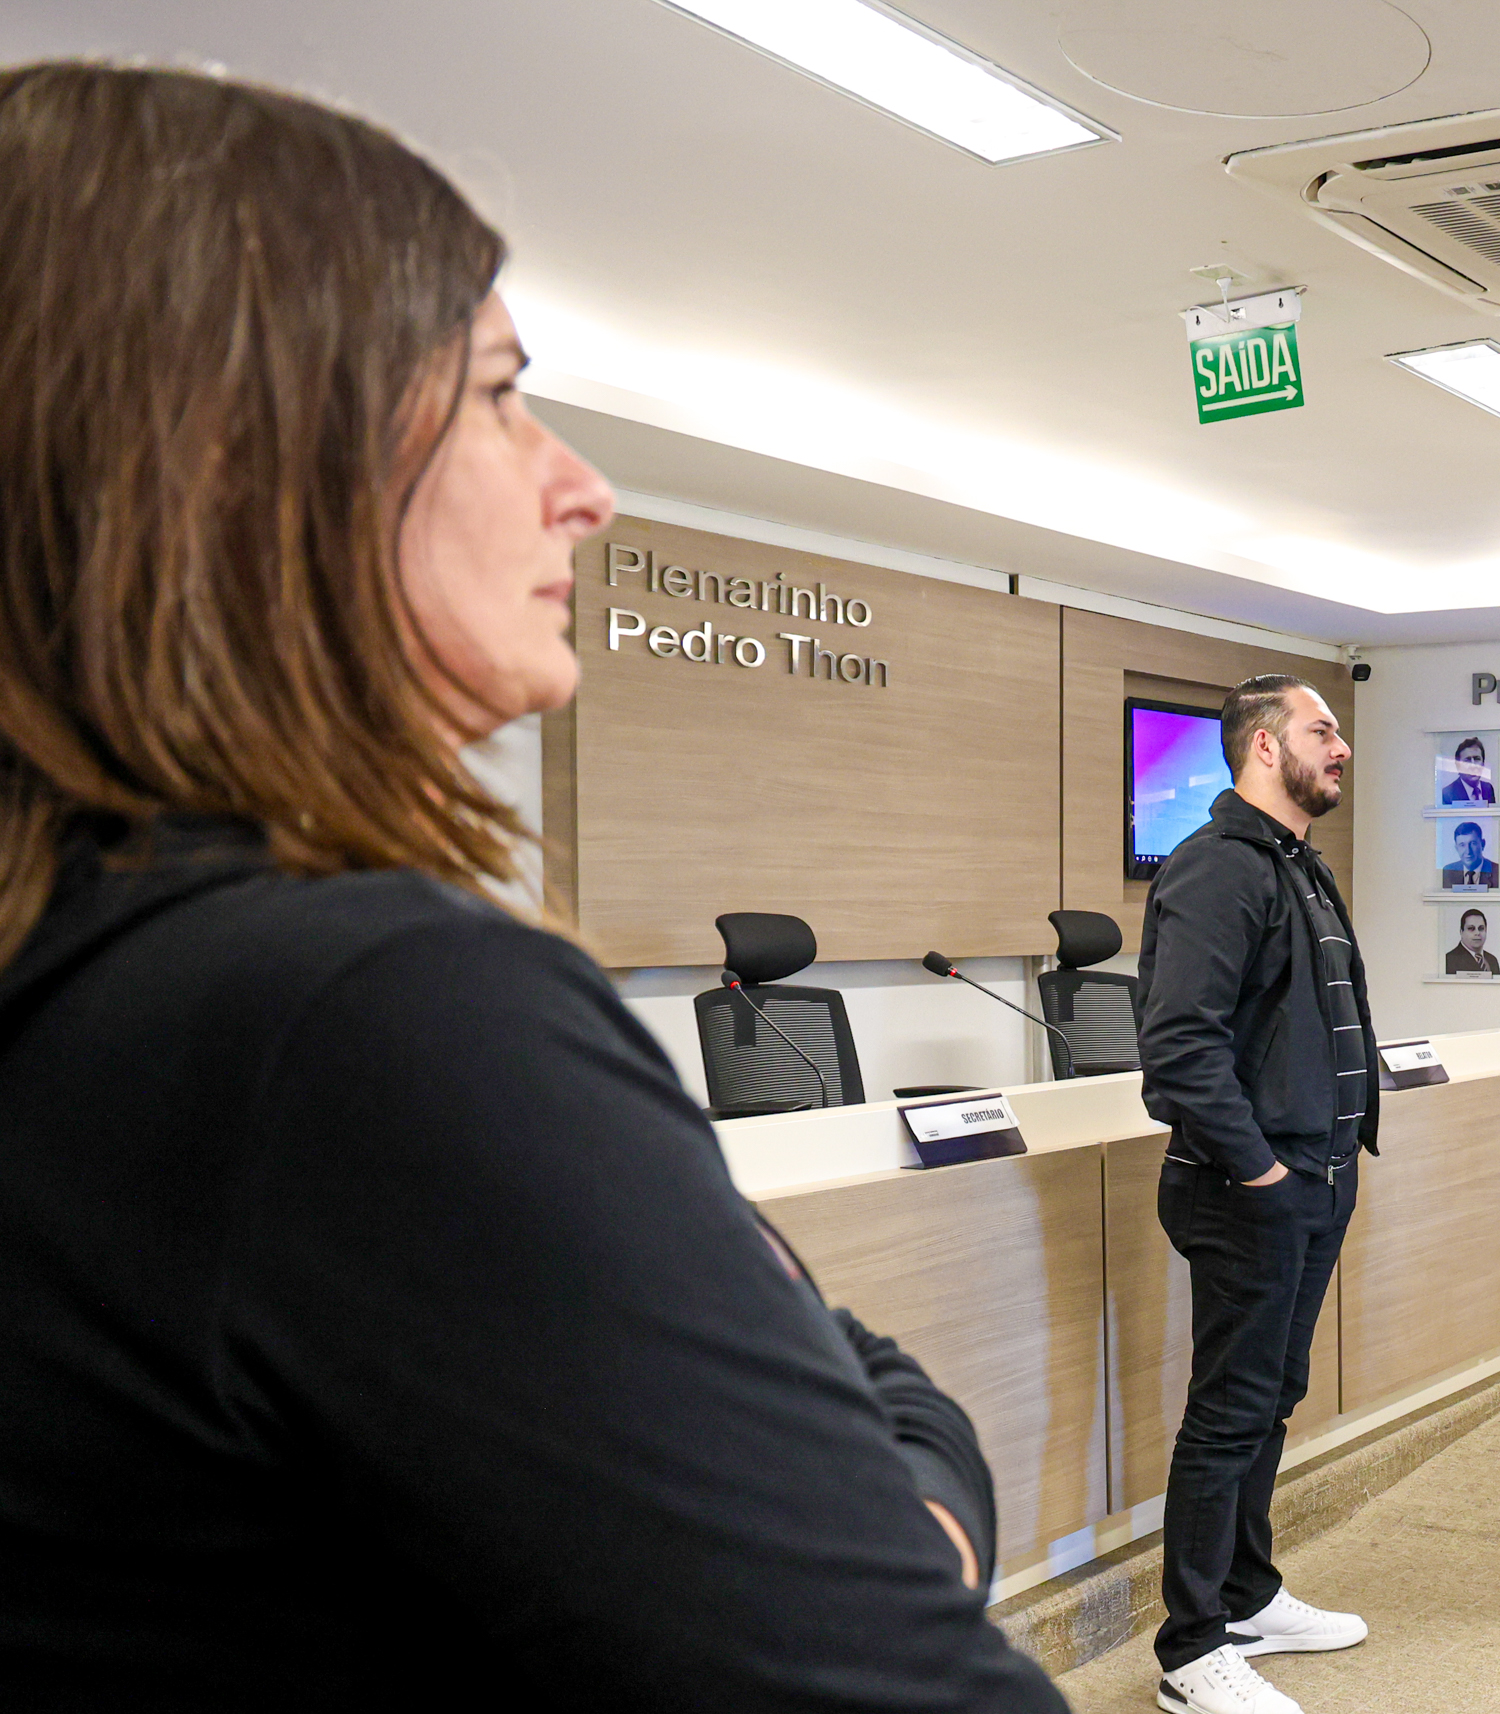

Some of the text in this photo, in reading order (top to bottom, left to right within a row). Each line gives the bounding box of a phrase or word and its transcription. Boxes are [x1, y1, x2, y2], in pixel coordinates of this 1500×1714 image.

[1196, 333, 1297, 398] SAÍDA
[605, 542, 873, 628] Plenarinho
[608, 607, 890, 687] Pedro Thon
[961, 1109, 1004, 1124] SECRETÁRIO
